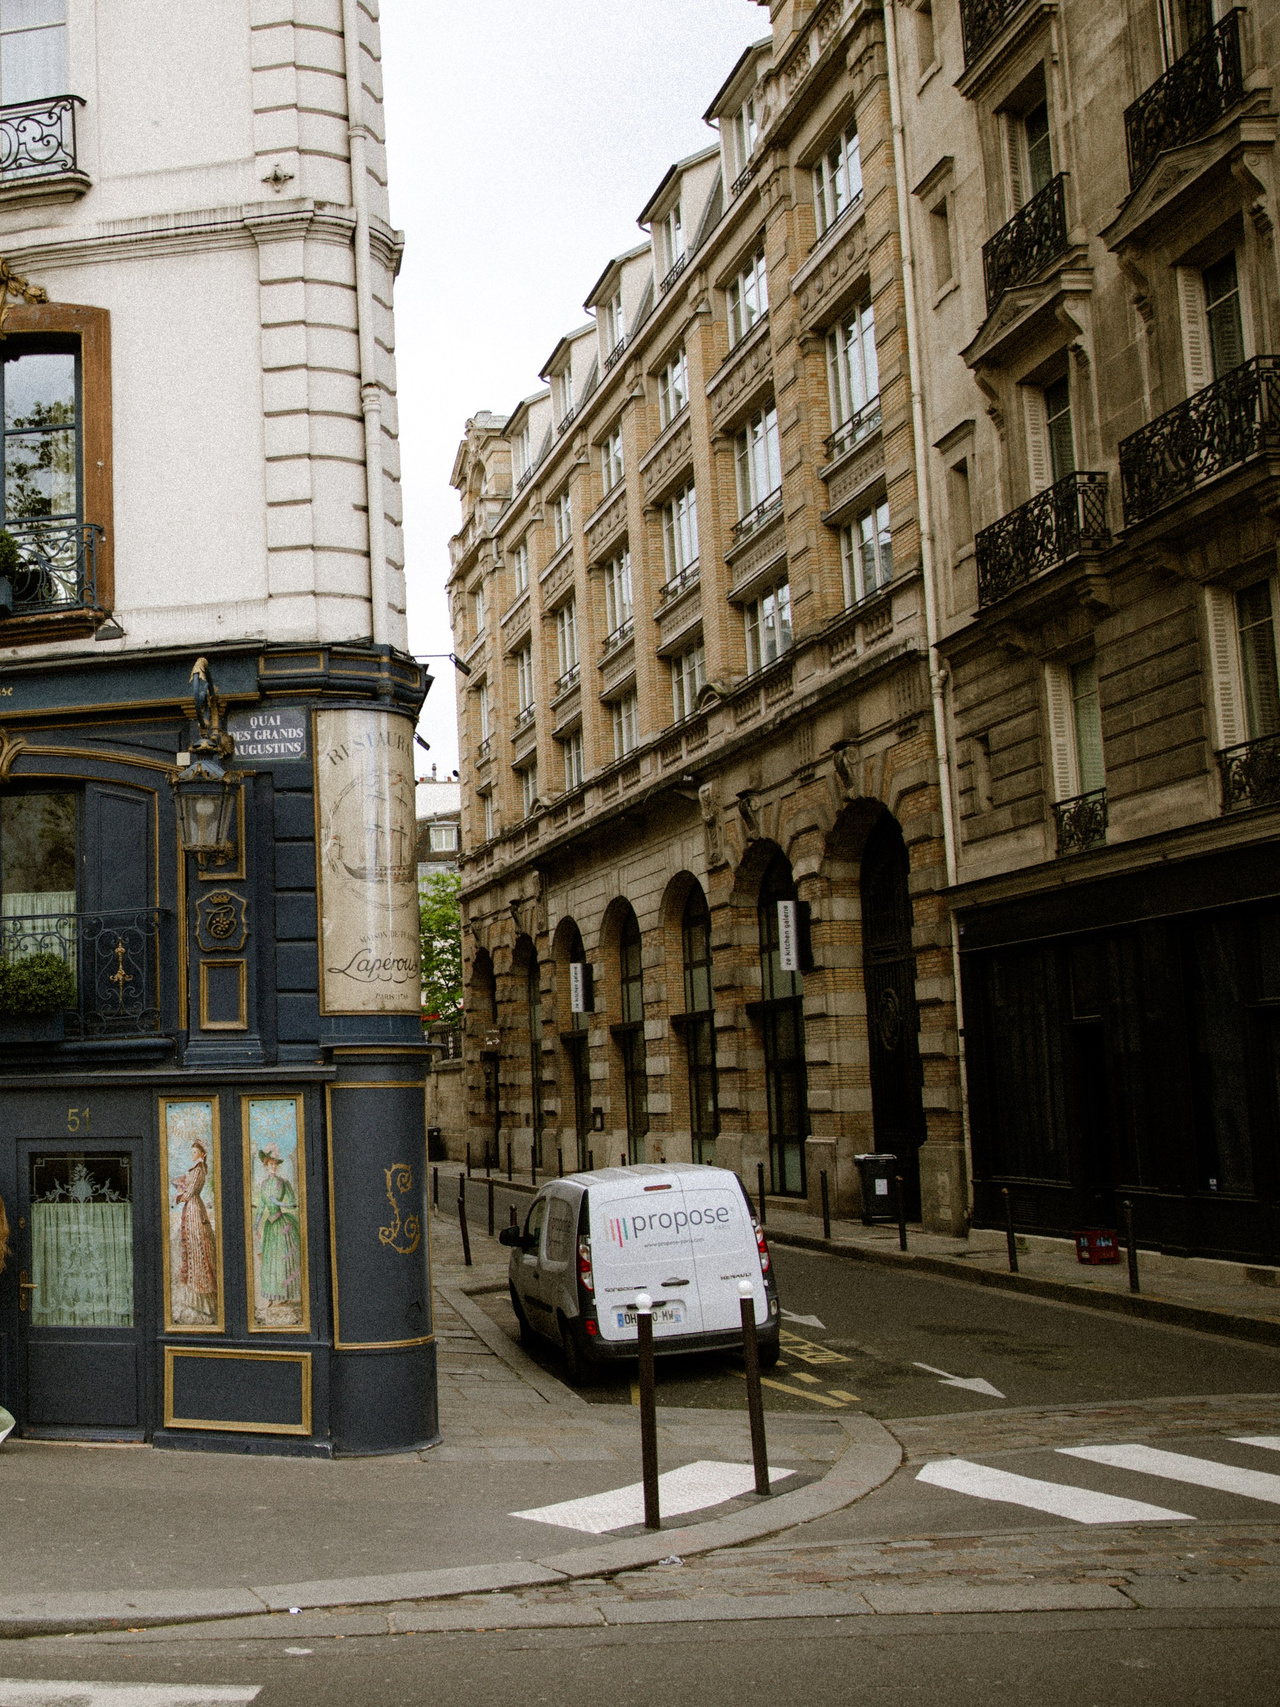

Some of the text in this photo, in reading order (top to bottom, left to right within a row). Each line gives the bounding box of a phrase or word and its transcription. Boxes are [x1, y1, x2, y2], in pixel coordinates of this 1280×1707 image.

[249, 715, 281, 729] QUAI
[228, 727, 304, 741] DES GRANDS
[233, 742, 302, 756] AUGUSTINS
[67, 1107, 90, 1133] 51
[631, 1206, 730, 1239] propose
